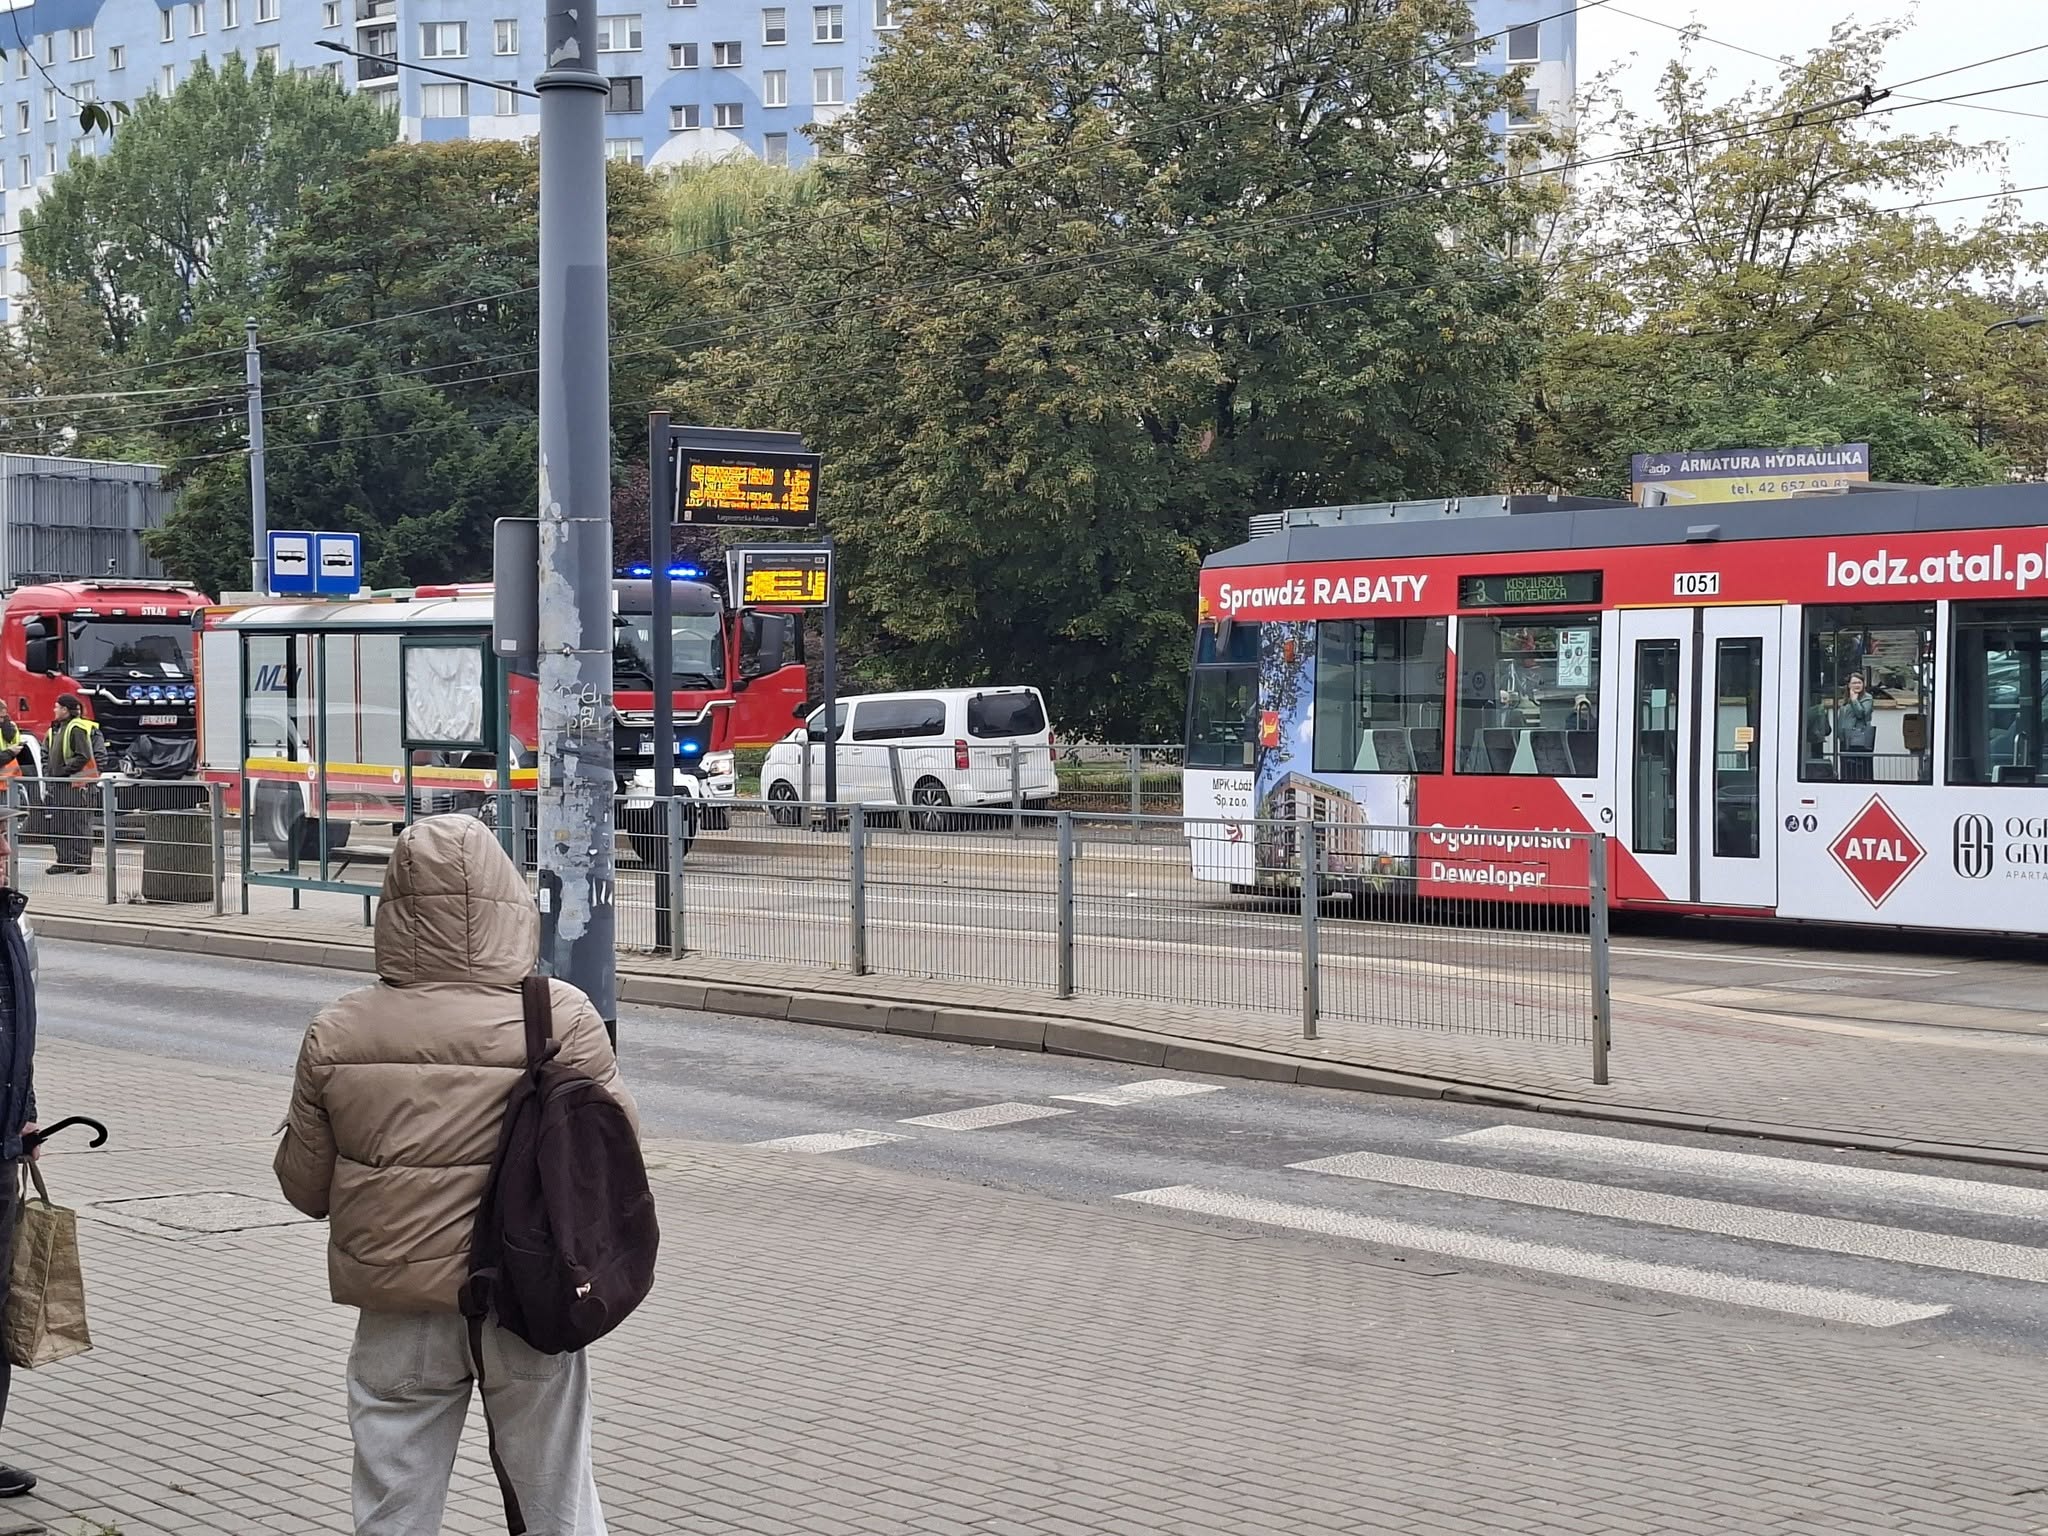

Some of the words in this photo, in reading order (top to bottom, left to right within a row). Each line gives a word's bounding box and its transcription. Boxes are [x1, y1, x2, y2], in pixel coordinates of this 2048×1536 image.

[1648, 463, 1671, 476] adp
[1680, 456, 1761, 473] ARMATURA
[1765, 451, 1863, 470] HYDRAULIKA
[1731, 483, 1754, 495] tel.
[1758, 482, 1775, 493] 42
[1780, 481, 1806, 493] 657
[1219, 578, 1305, 616] Sprawdź
[1313, 574, 1428, 605] RABATY
[1475, 579, 1486, 603] 3
[1676, 574, 1718, 594] 1051
[1212, 778, 1252, 791] MPK-Łódź
[1844, 837, 1908, 862] ATAL
[1430, 862, 1547, 892] Deweloper
